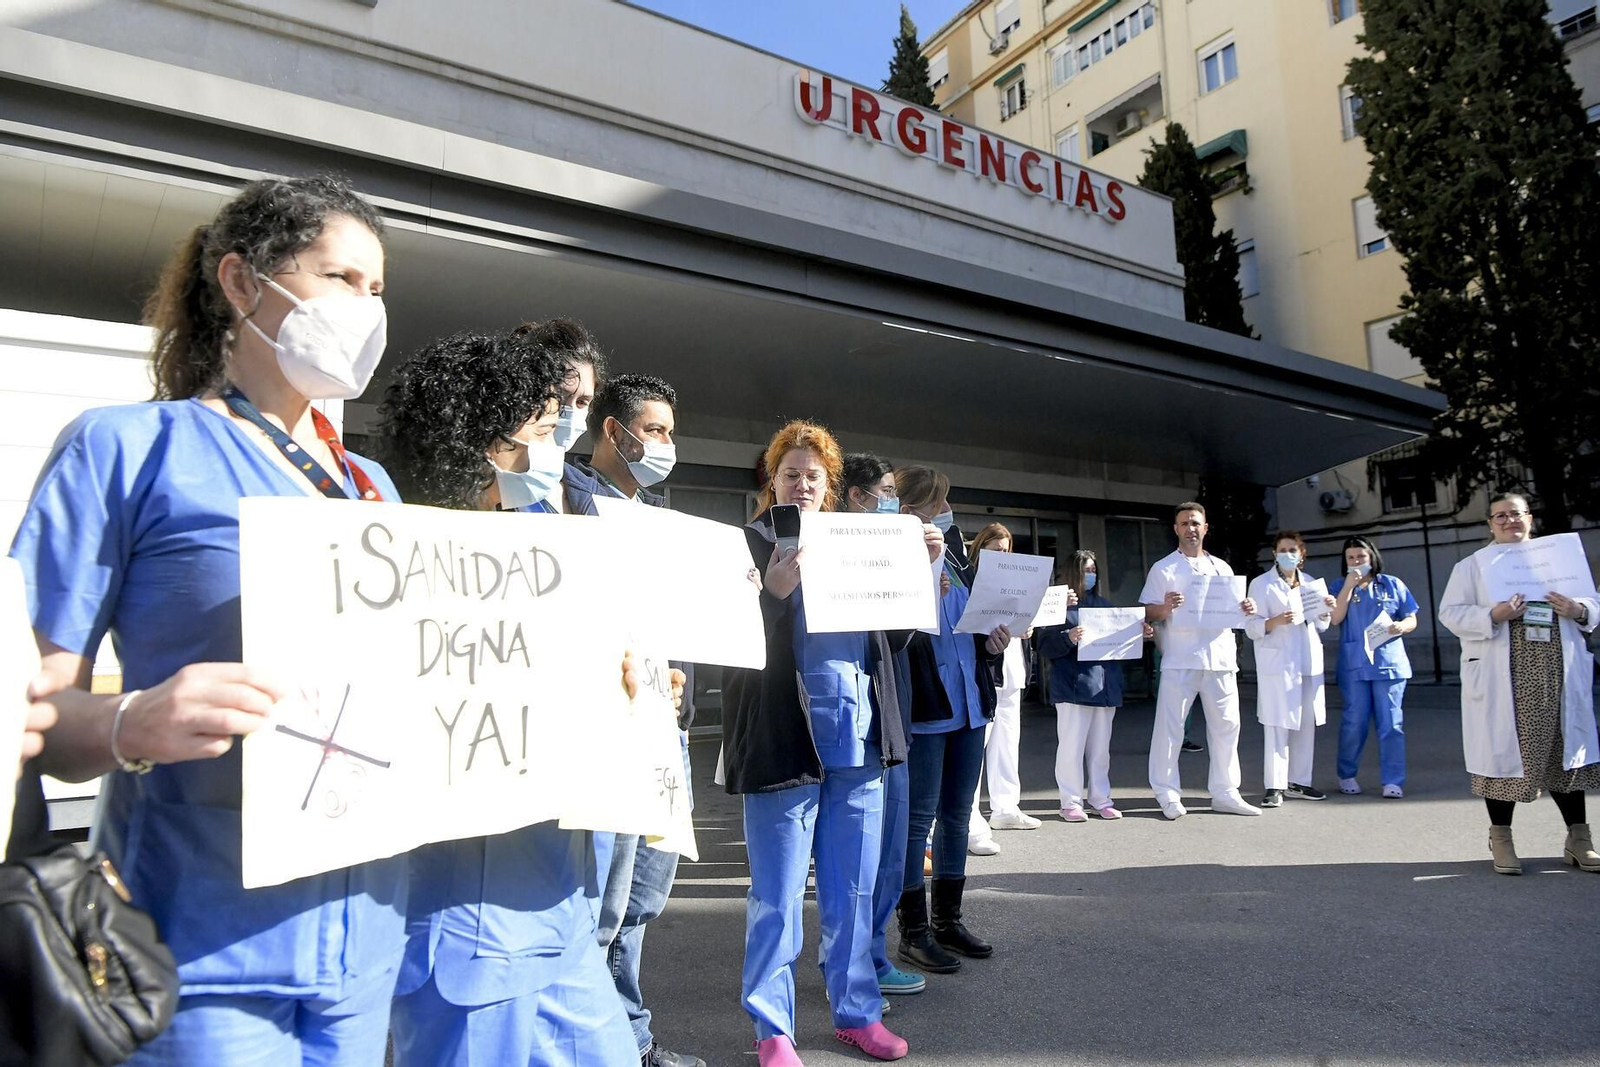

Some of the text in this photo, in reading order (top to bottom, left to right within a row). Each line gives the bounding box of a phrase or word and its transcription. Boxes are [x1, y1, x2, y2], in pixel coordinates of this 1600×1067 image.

[796, 69, 1126, 223] URGENCIAS
[829, 527, 903, 536] PARA UNA SANIDAD
[434, 699, 530, 785] YA!
